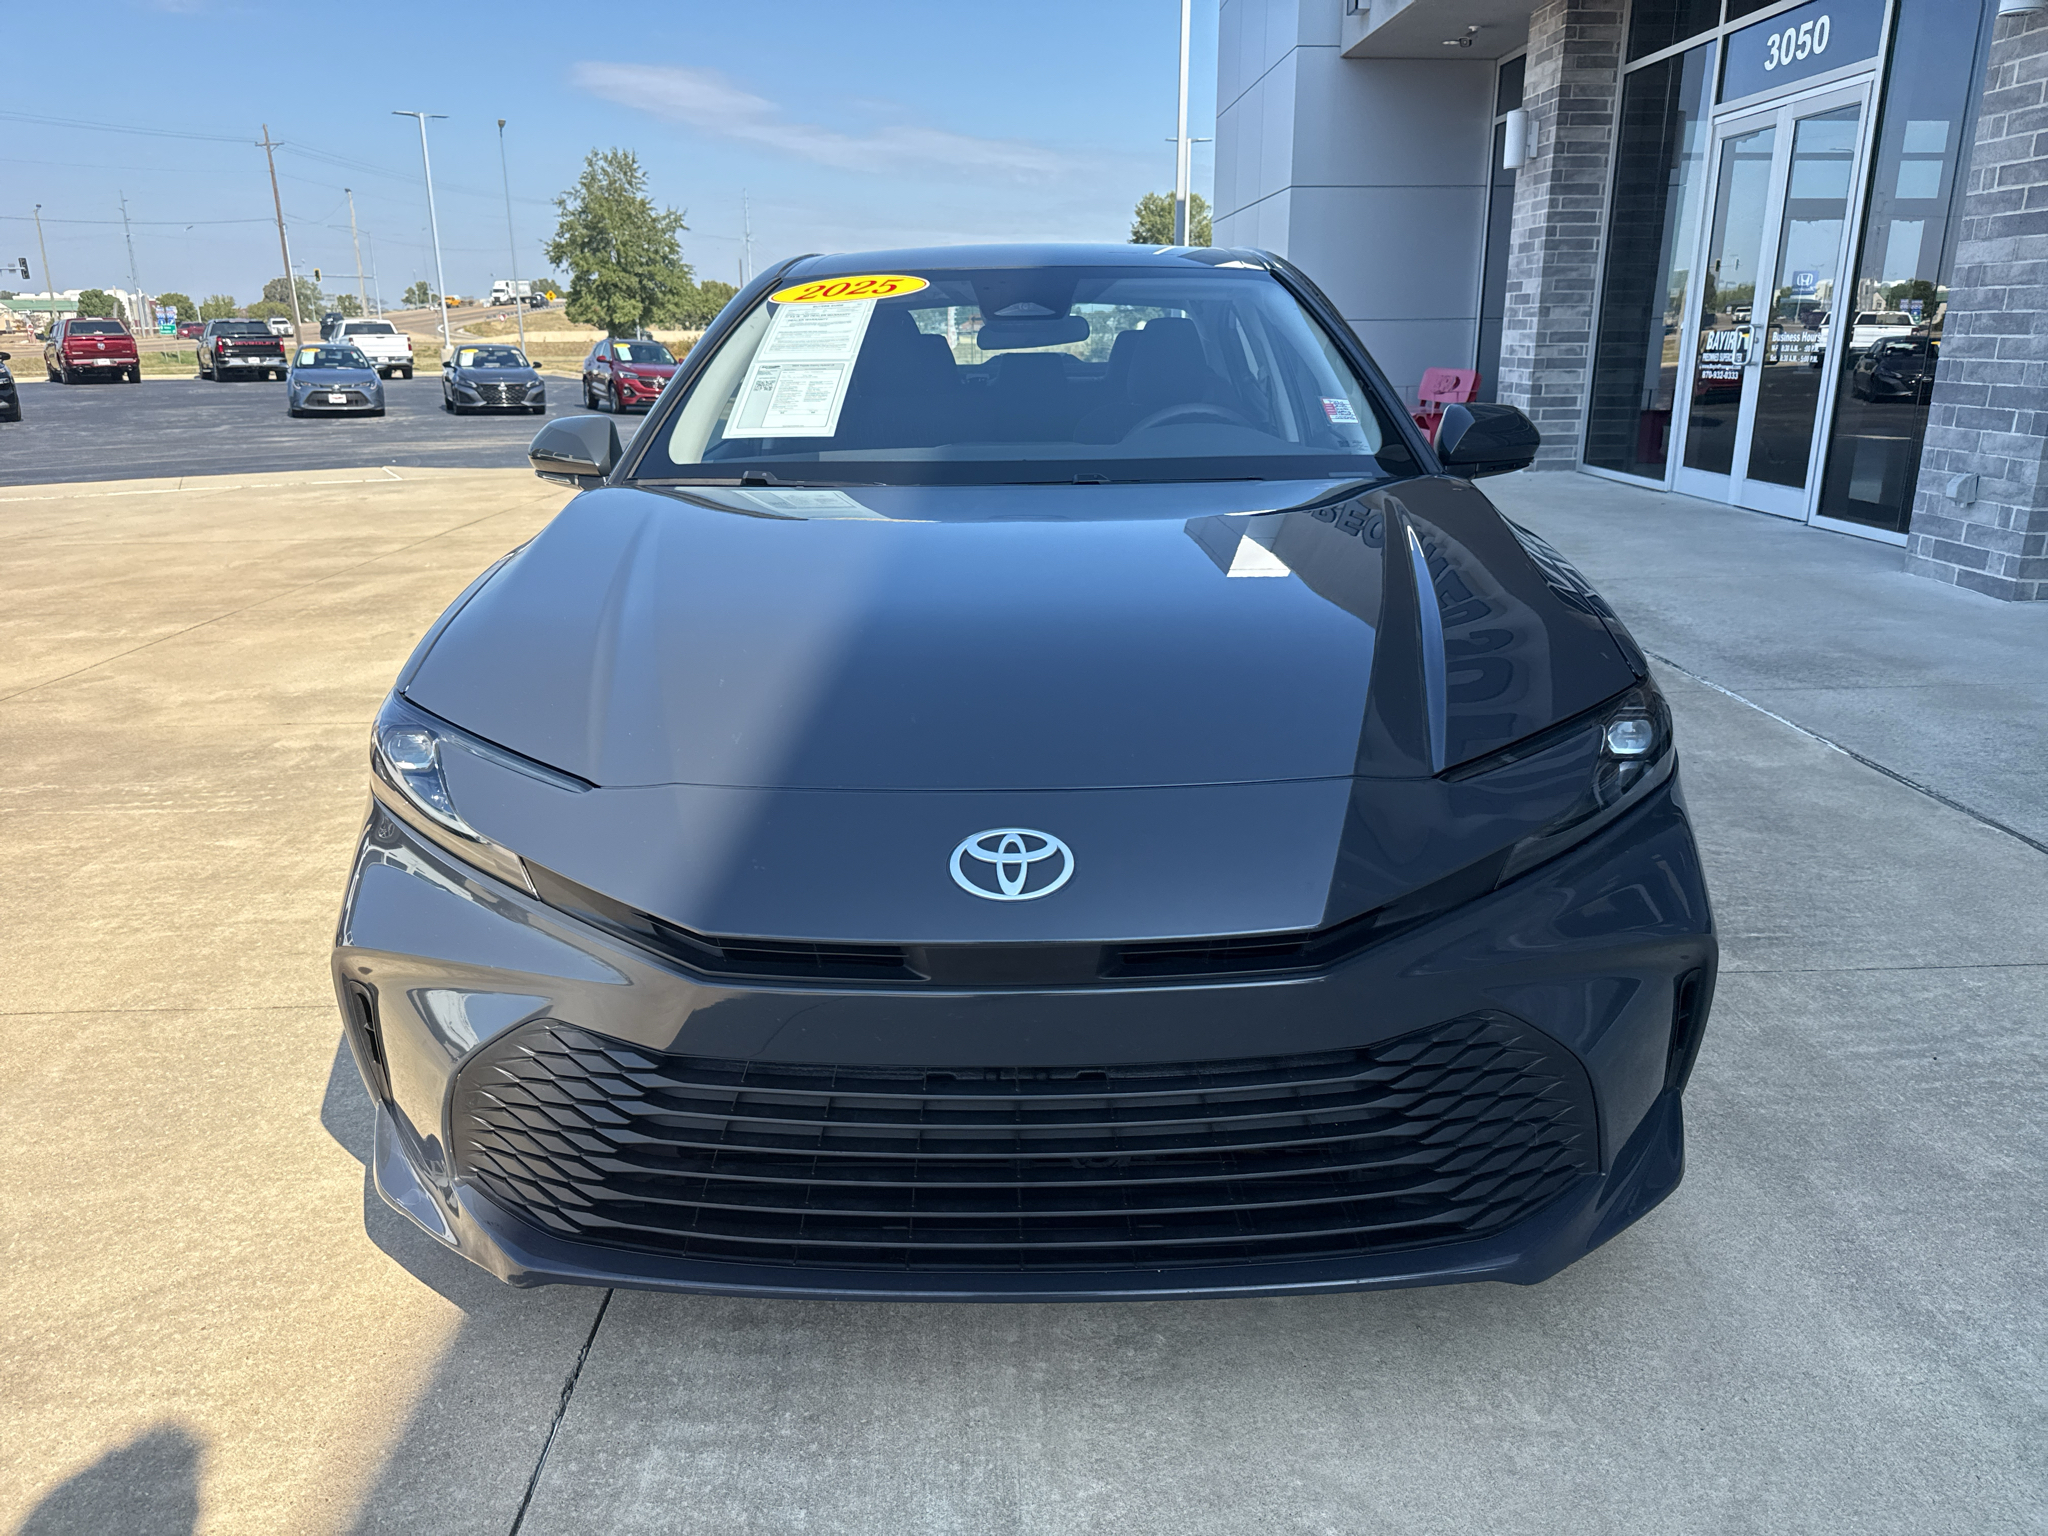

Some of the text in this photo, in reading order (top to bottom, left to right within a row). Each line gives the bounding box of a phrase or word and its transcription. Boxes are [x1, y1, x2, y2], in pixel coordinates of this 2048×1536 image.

[1764, 14, 1830, 71] 3050
[794, 278, 904, 301] 2025
[1772, 331, 1822, 342] Business Hours
